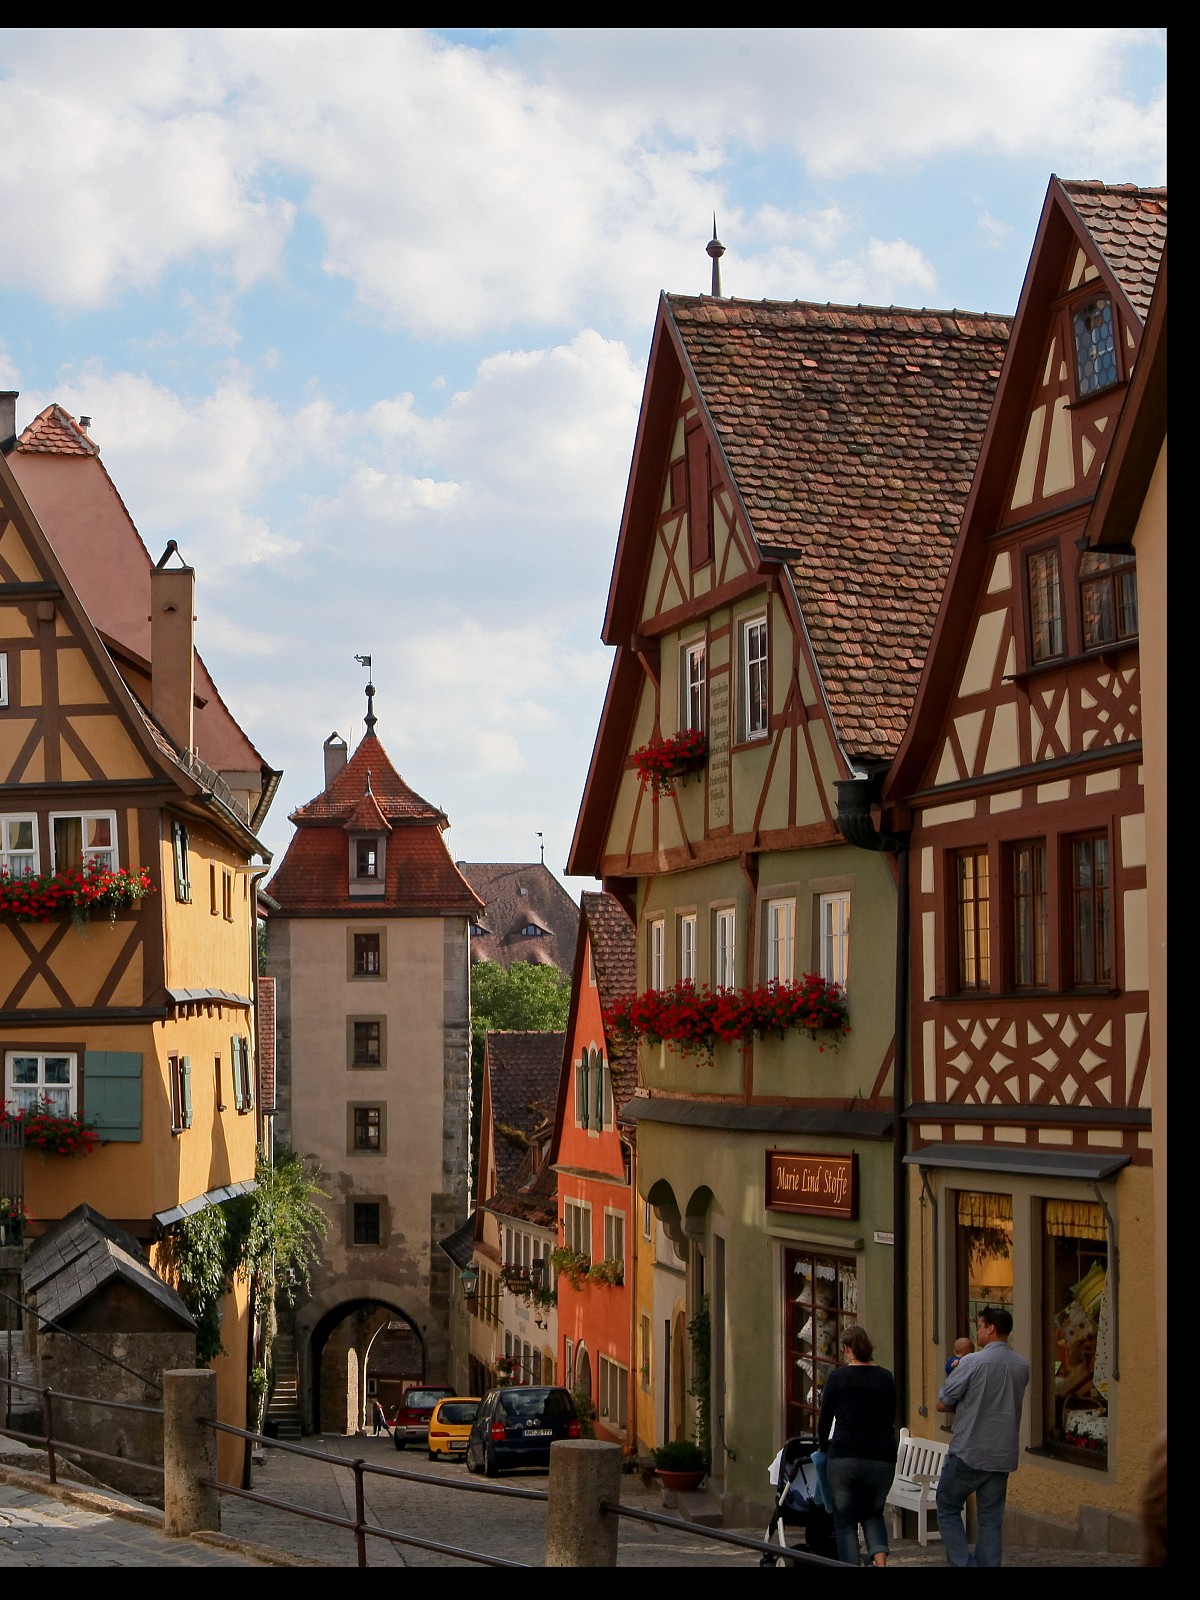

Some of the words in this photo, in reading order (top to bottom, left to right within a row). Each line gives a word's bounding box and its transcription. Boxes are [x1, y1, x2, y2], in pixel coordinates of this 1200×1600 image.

[776, 1166, 800, 1191] Marie
[801, 1165, 822, 1193] Lind
[823, 1166, 848, 1204] Stoffe
